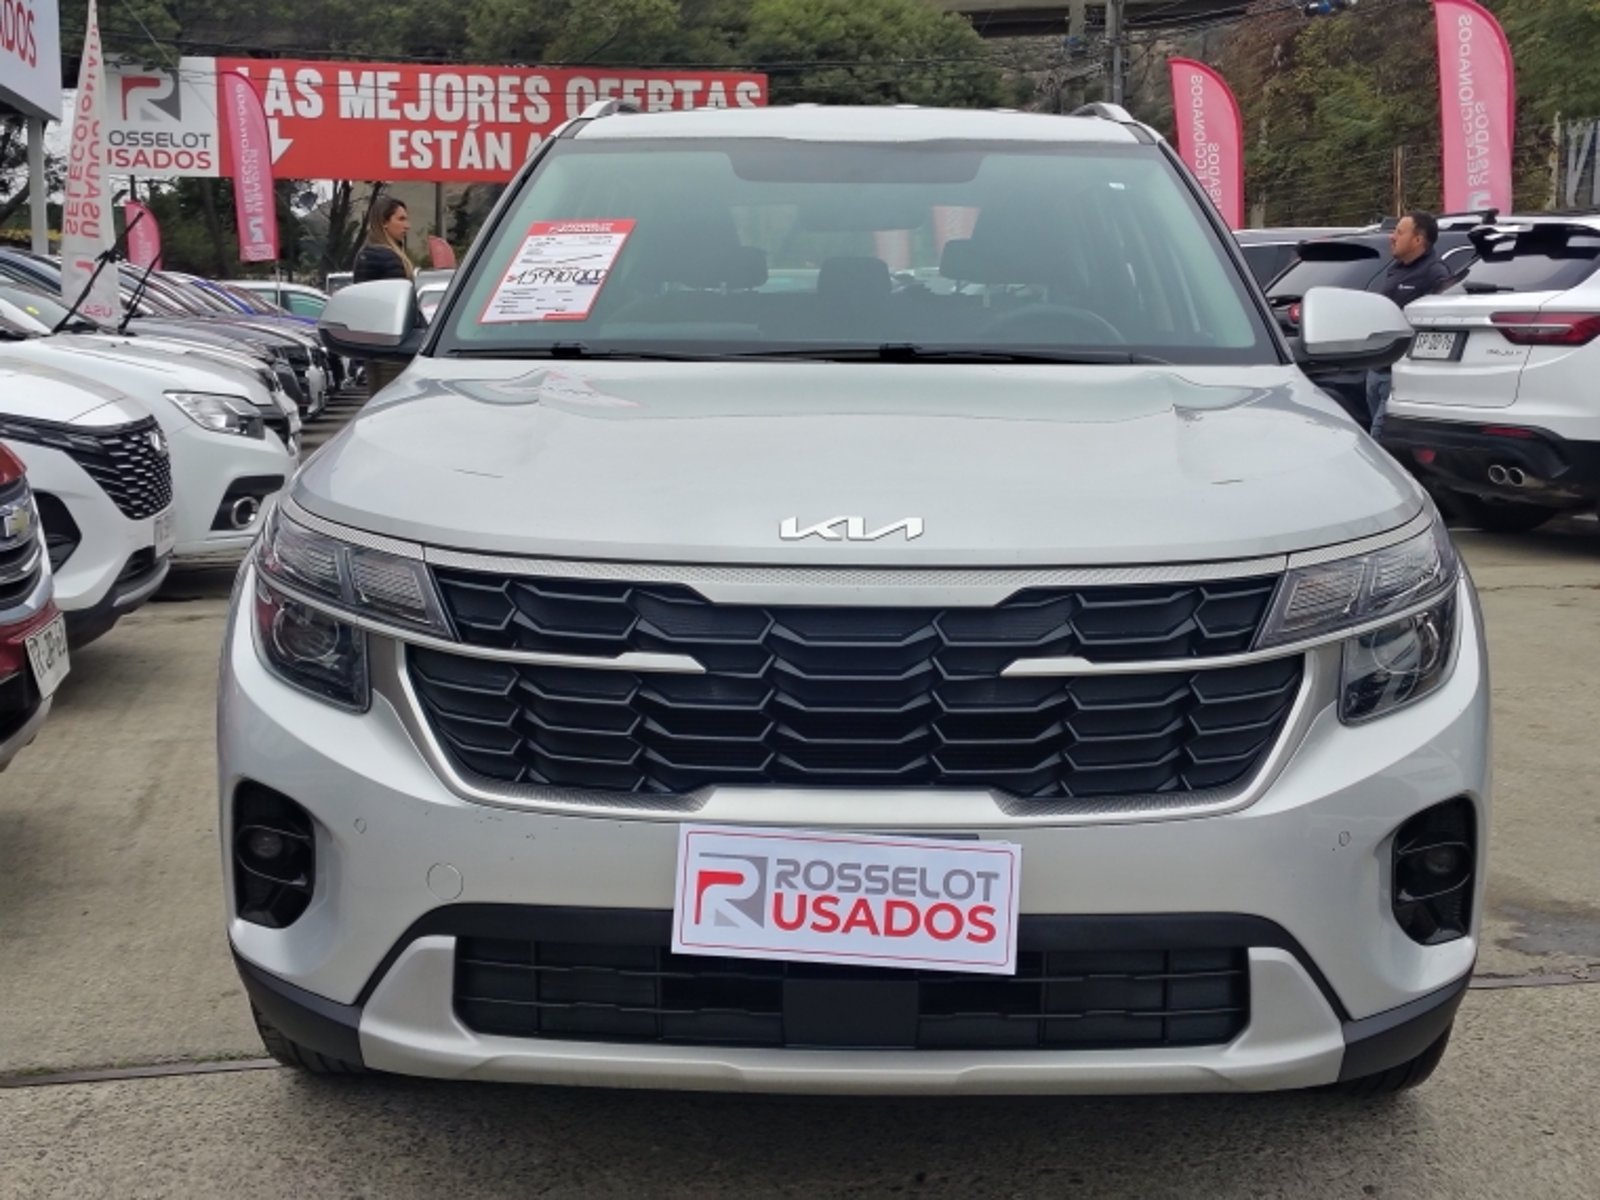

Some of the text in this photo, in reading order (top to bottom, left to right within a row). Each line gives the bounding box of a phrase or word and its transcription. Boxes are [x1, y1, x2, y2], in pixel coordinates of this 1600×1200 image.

[236, 67, 323, 119] AS
[338, 70, 551, 124] MEJORES
[108, 129, 212, 149] OSSELOT
[389, 123, 512, 170] ESTÁN
[775, 857, 1000, 902] ROSSELOT
[772, 891, 997, 945] USADOS
